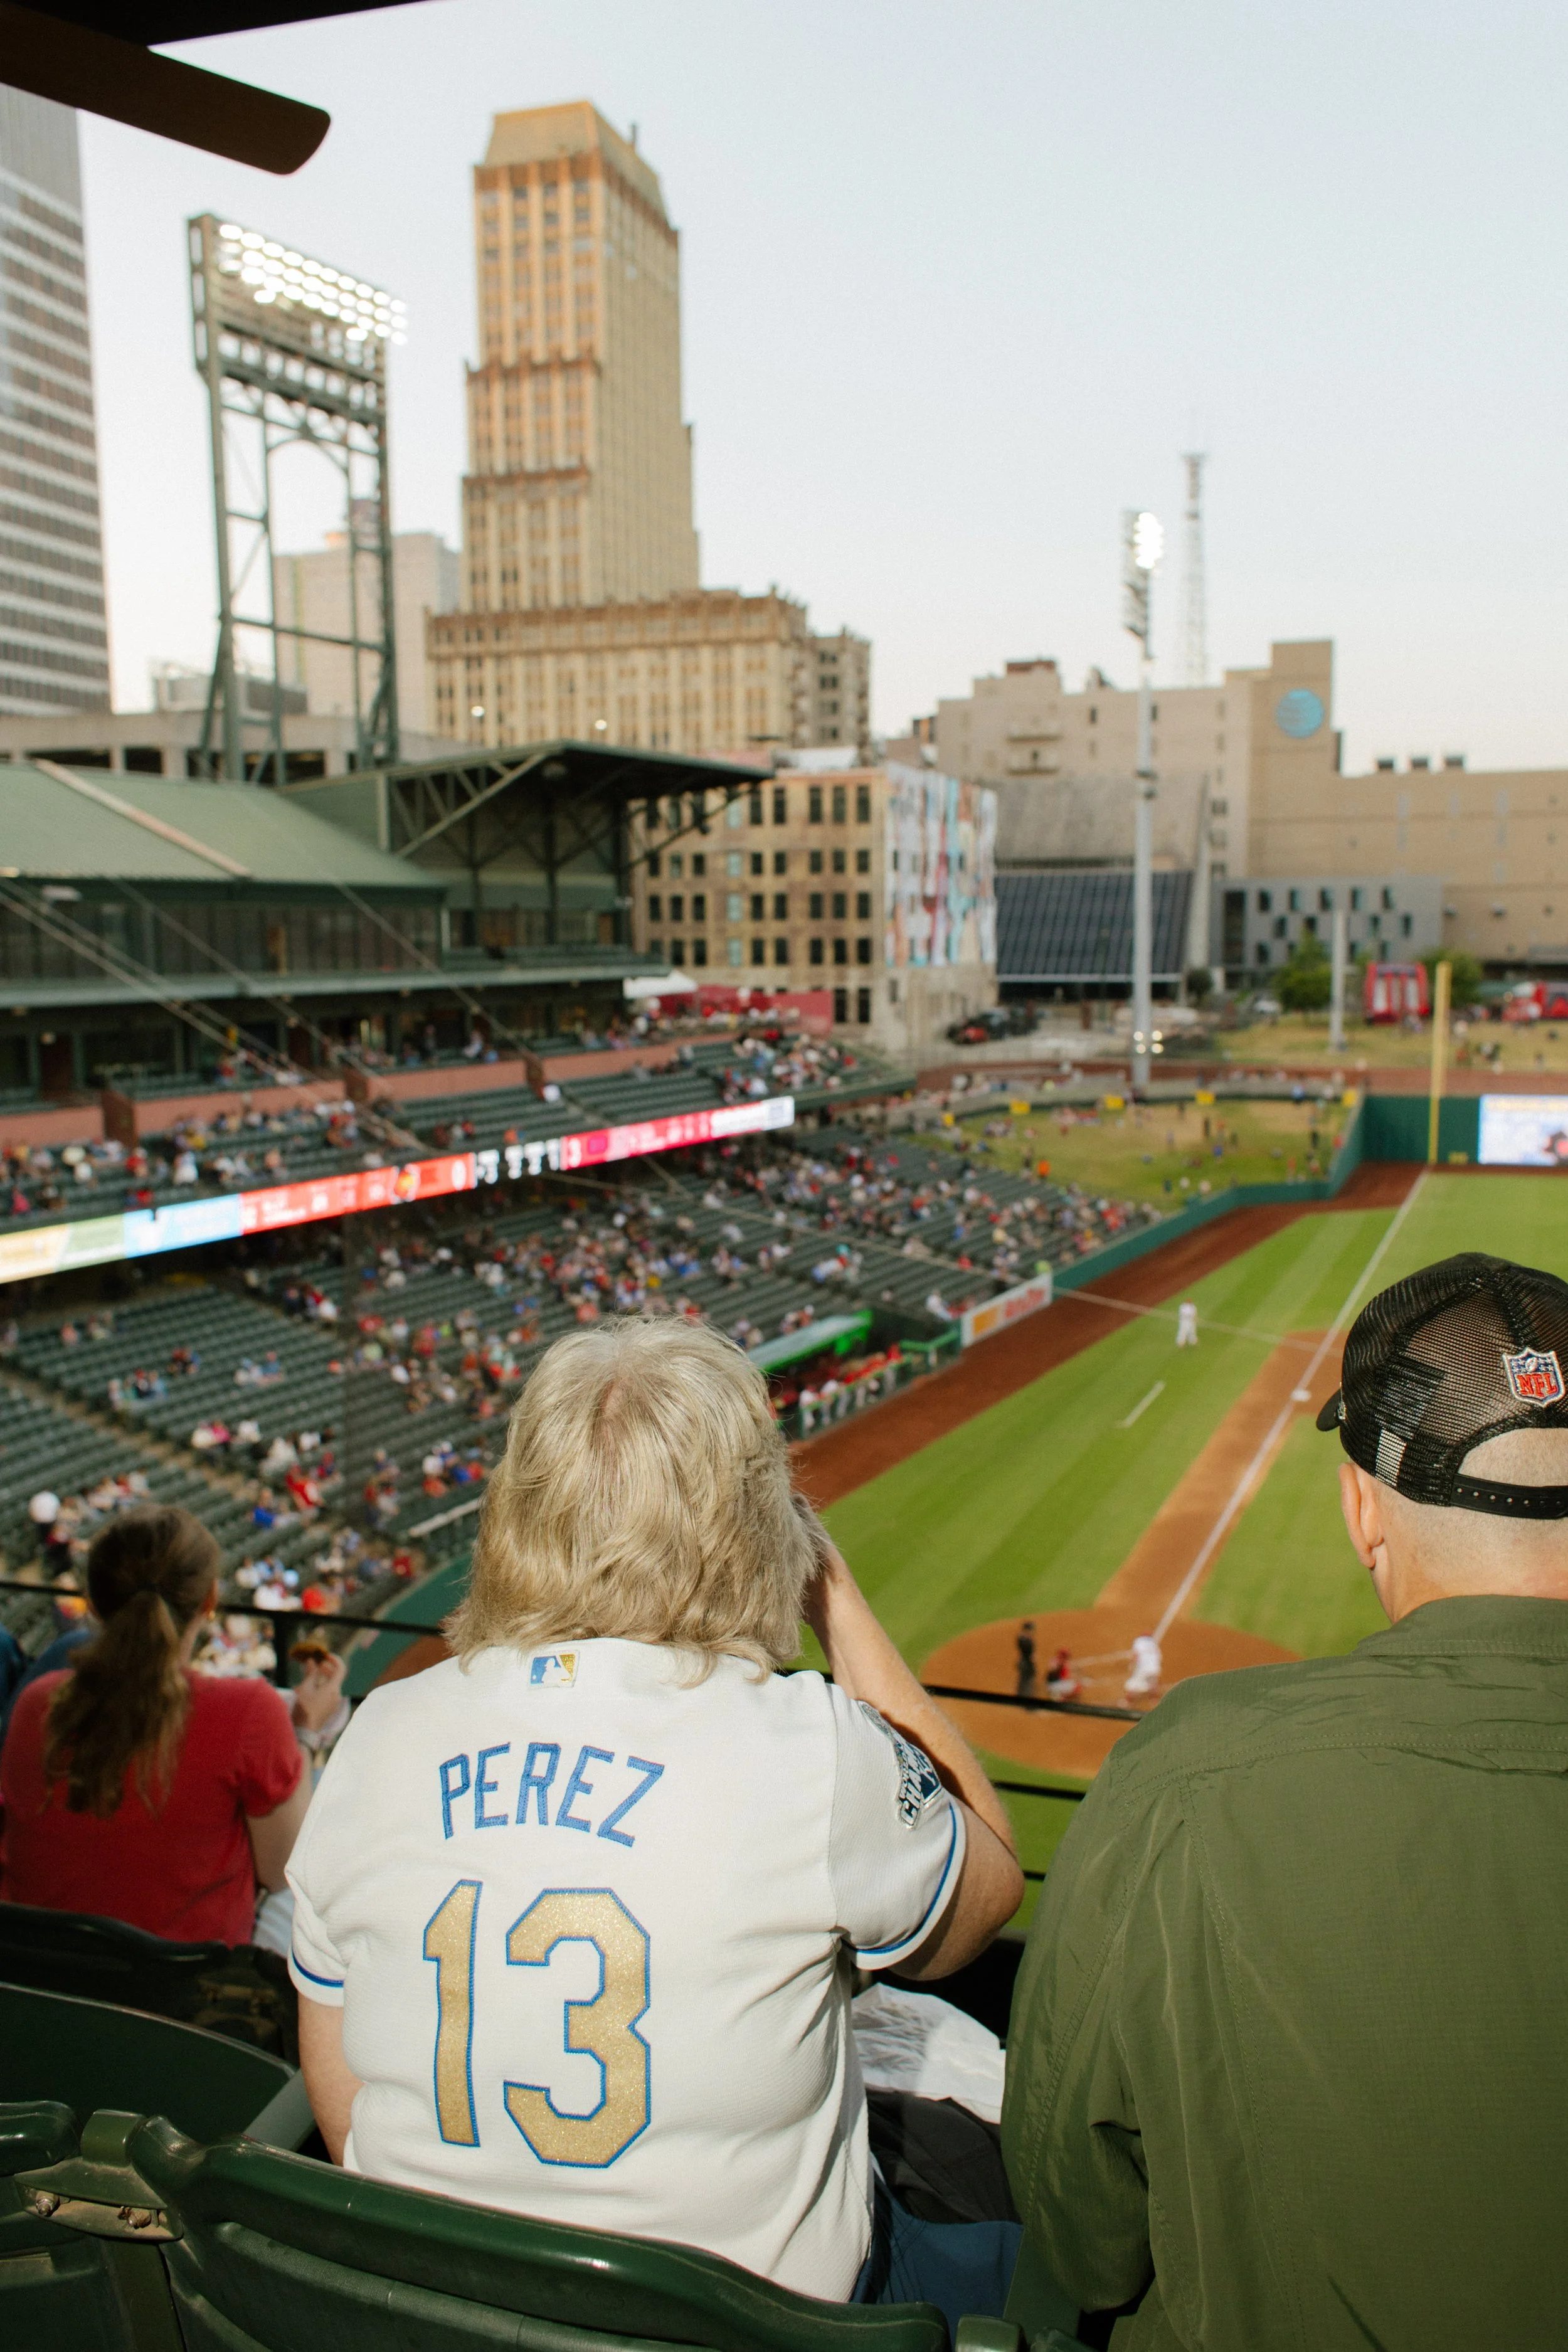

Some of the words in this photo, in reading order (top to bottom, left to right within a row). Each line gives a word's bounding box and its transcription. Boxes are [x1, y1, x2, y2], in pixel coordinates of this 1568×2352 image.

[1517, 1374, 1557, 1397] NFL
[439, 1742, 665, 1848] PEREZ
[423, 1879, 650, 2168] 13
